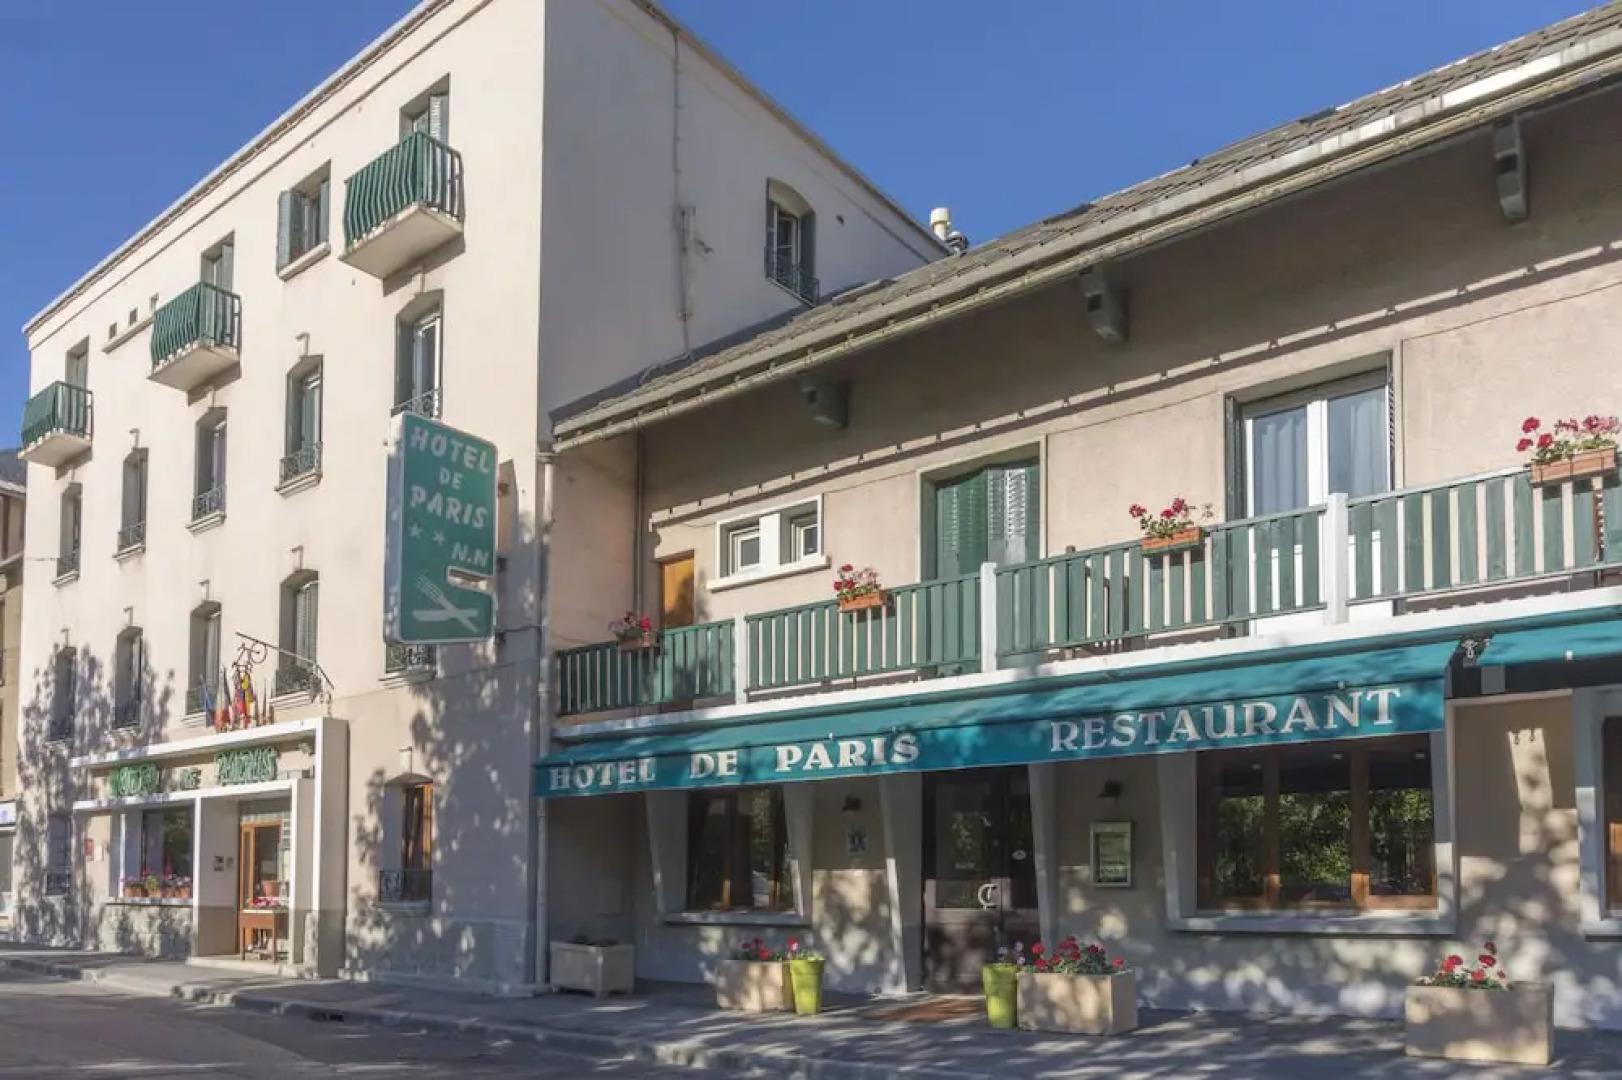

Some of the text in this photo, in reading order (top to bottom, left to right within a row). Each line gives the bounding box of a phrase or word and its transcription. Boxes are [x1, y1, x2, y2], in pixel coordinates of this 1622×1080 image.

[411, 427, 489, 473] HOTEL
[438, 466, 463, 490] DE
[410, 485, 488, 529] PARIS
[549, 687, 1401, 790] HOTEL DE PARIS RESTAURANT
